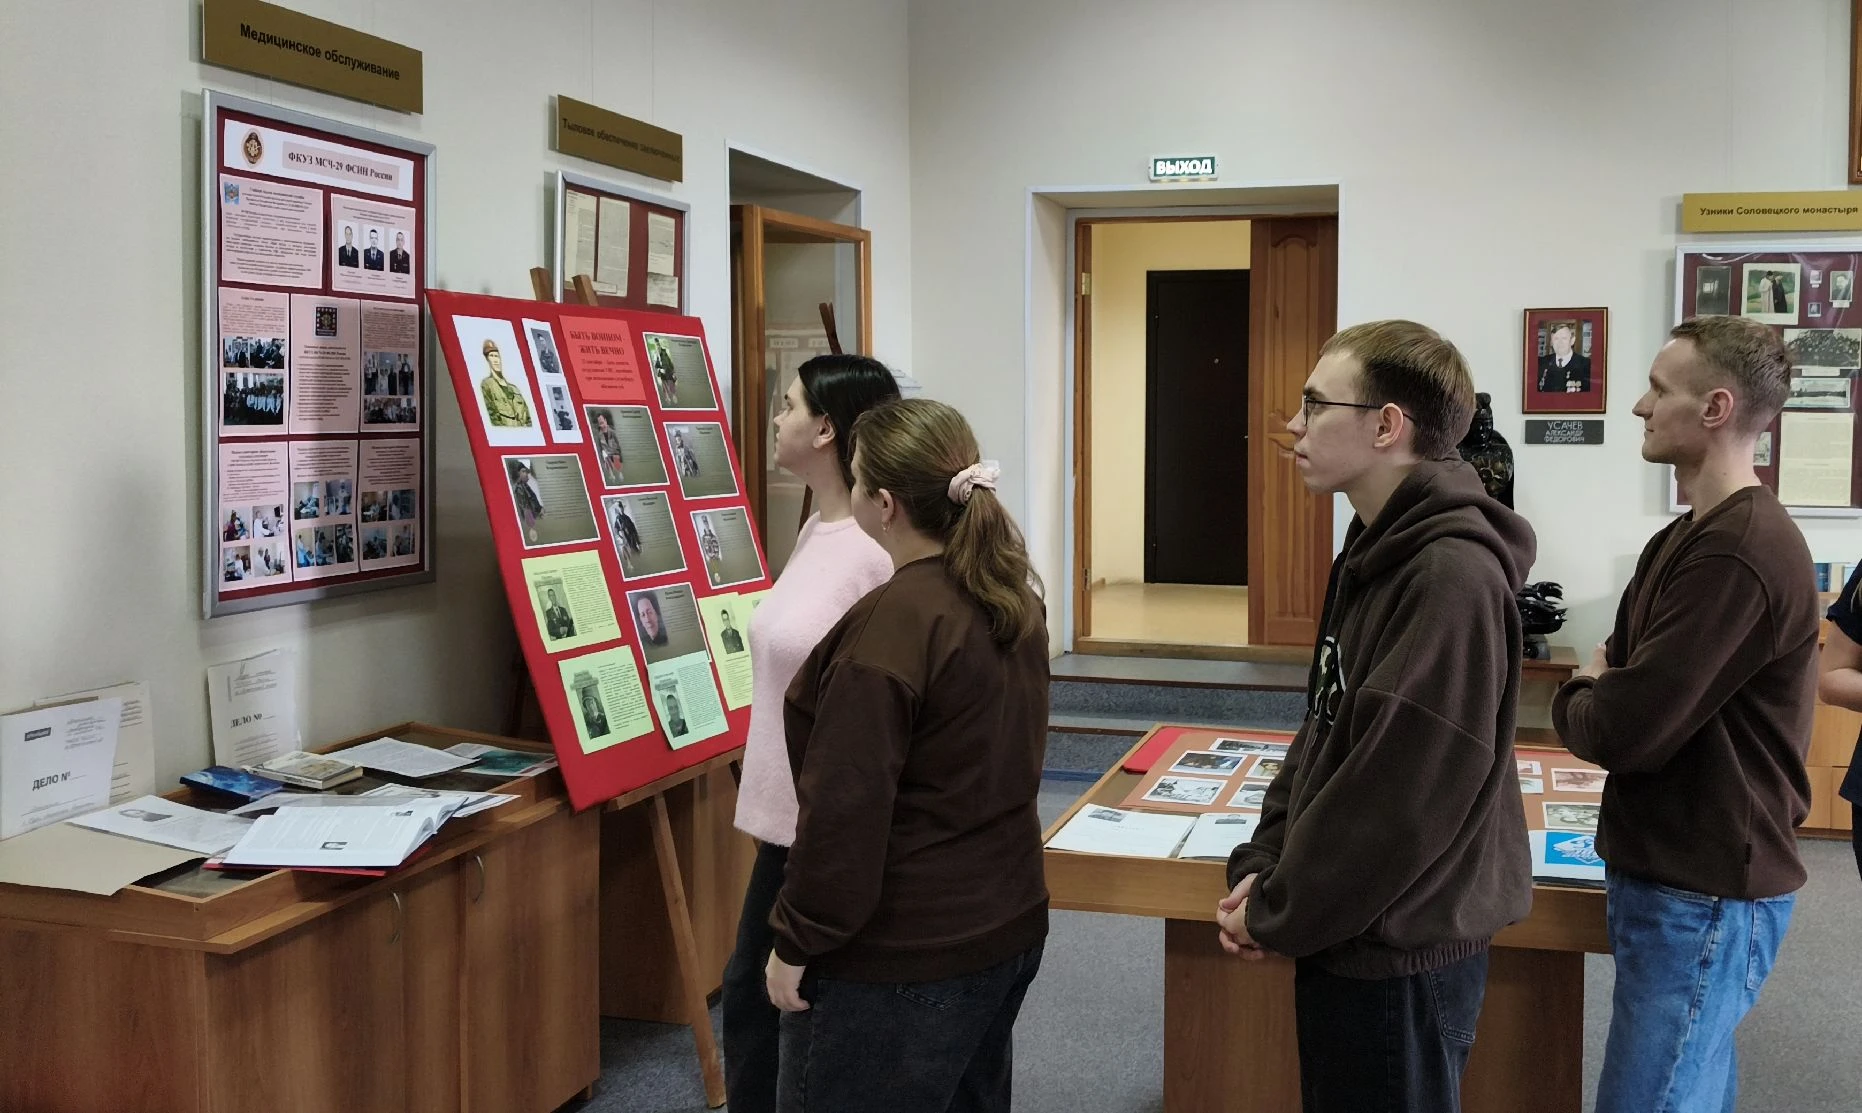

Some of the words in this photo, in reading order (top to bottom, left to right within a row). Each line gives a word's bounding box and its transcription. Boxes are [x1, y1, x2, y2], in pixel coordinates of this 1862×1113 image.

[240, 23, 322, 58] Медицинское
[324, 50, 400, 80] обслуживание
[288, 152, 313, 165] ФКУЗ
[315, 156, 344, 171] МСЧ-29
[345, 163, 368, 177] ФСИН
[370, 168, 393, 181] России
[1156, 158, 1213, 175] ВЫХОД
[1699, 207, 1734, 216] Узники
[1736, 206, 1800, 216] Соловецкого
[1802, 206, 1859, 216] монастыря
[1545, 429, 1584, 437] АЛЕКСАНДР
[1547, 420, 1584, 431] УСАЧЕВ
[1543, 435, 1585, 444] ФЕДОРОВИЧ
[230, 714, 252, 729] ДЕЛО
[32, 774, 59, 791] ДЕЛО
